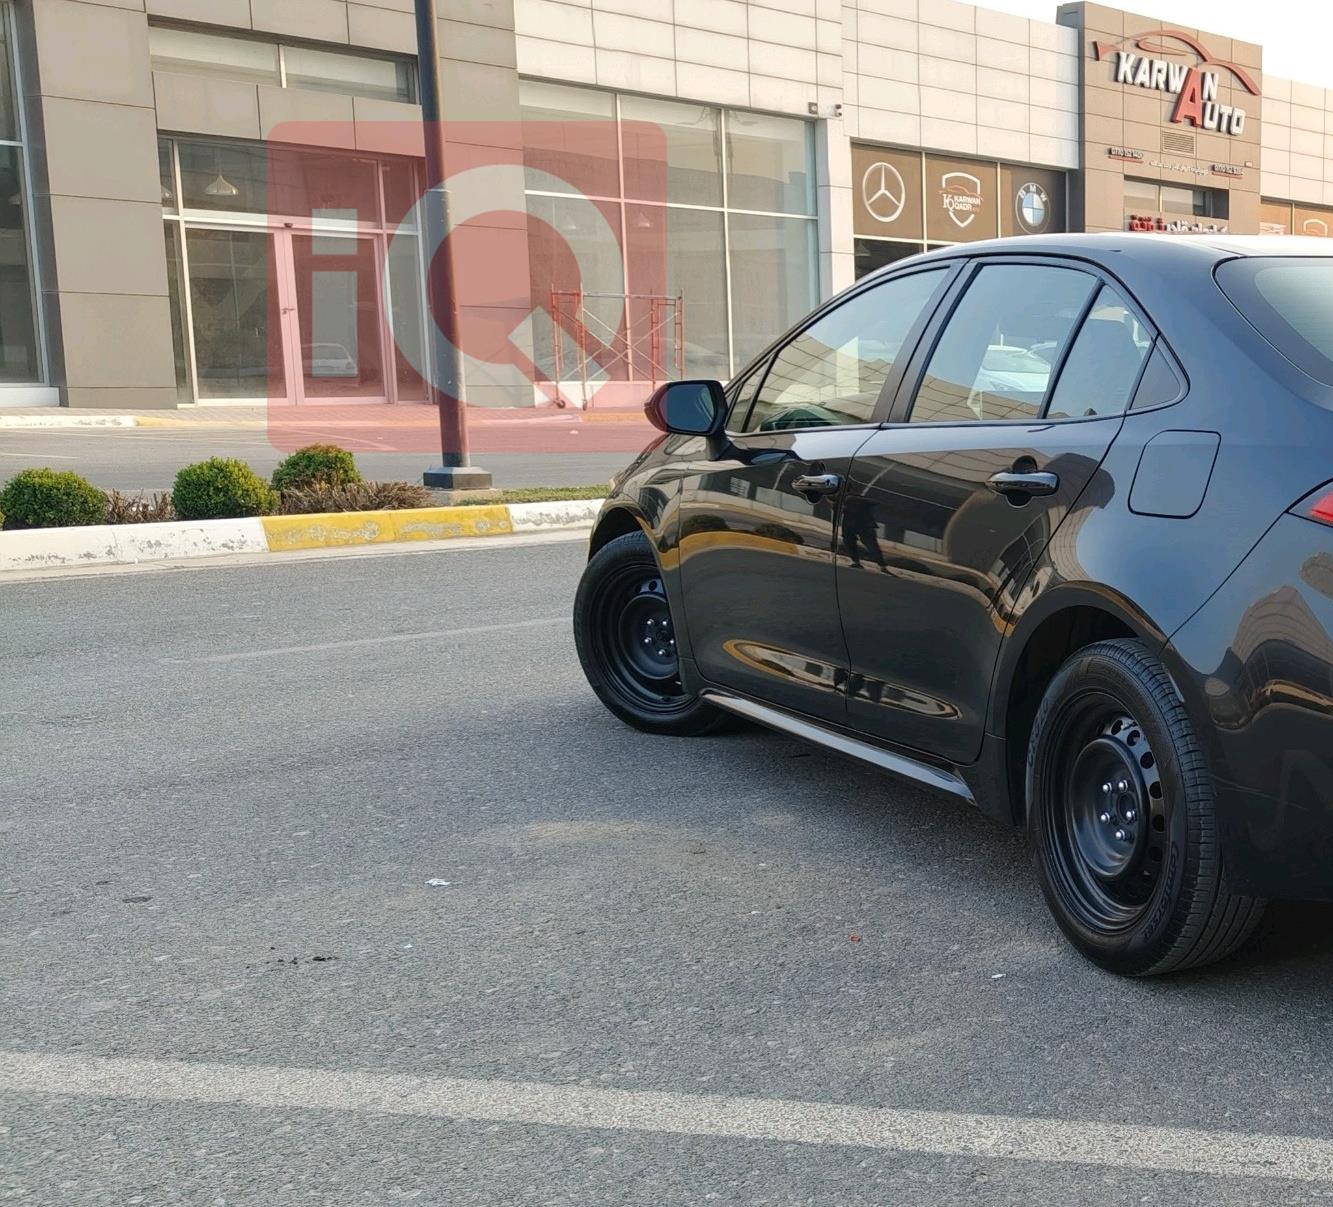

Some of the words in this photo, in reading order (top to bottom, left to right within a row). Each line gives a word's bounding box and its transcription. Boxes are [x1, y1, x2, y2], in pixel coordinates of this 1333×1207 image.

[1116, 51, 1219, 110] KARWAN
[954, 195, 981, 206] KARWAN
[1020, 184, 1048, 202] BMW
